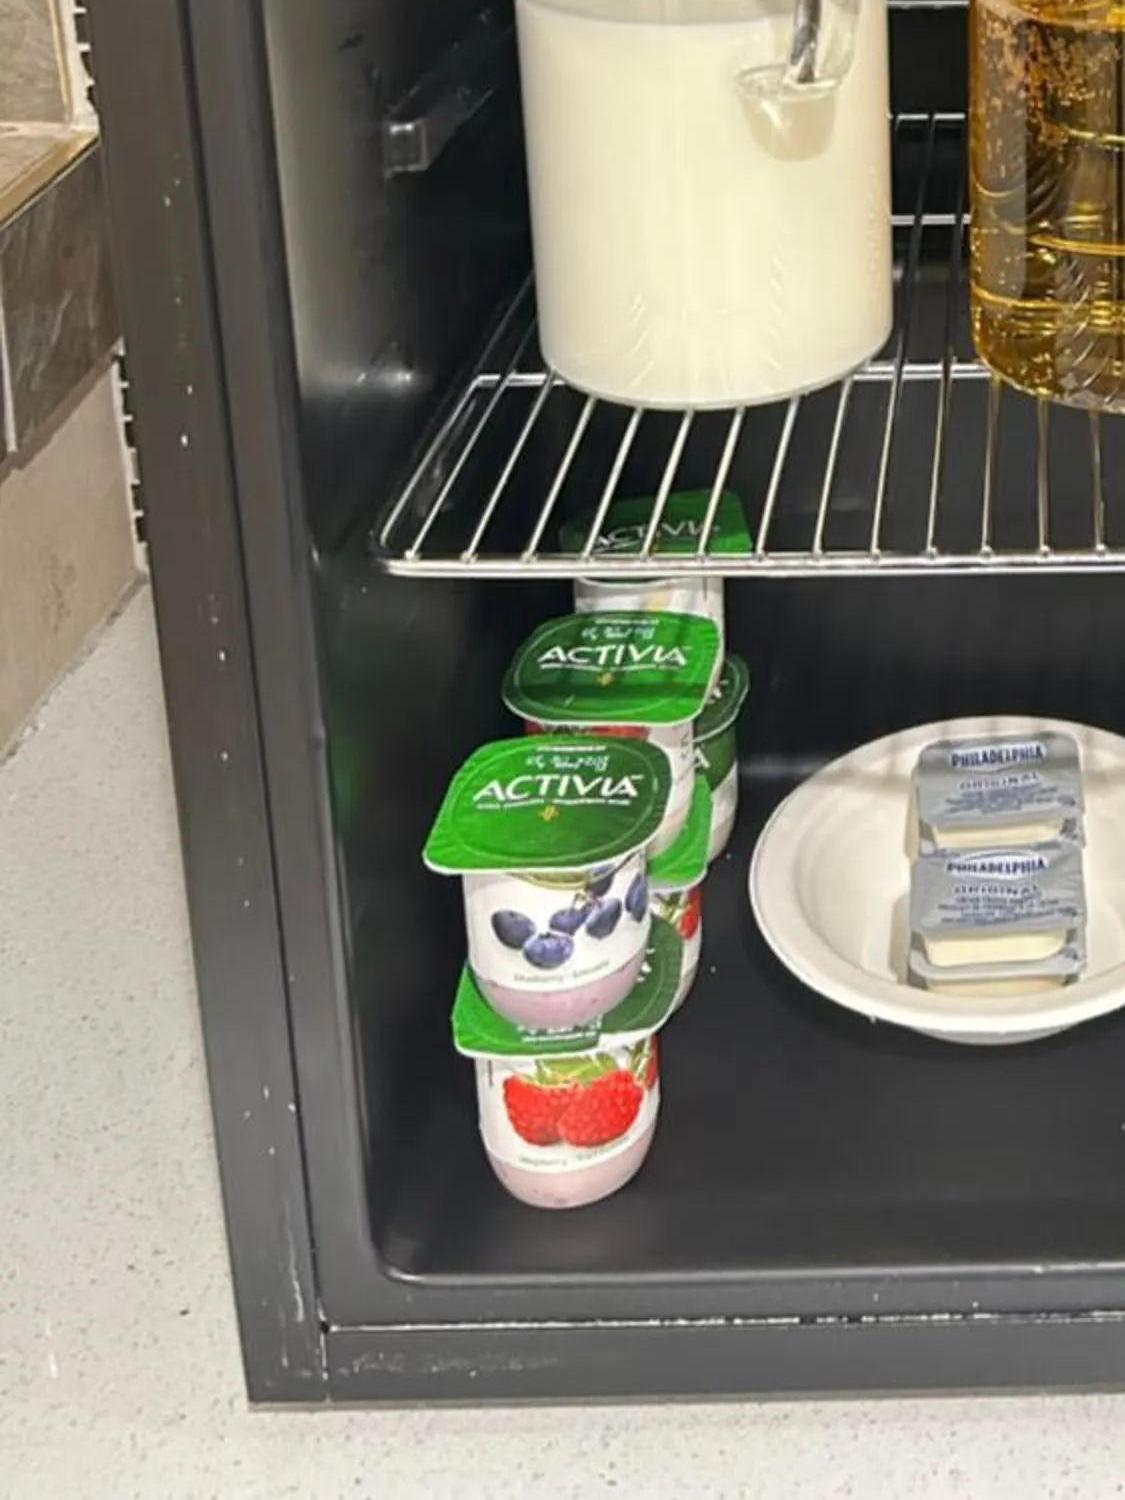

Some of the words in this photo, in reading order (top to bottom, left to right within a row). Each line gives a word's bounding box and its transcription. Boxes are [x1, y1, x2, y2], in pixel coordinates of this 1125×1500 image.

[537, 643, 688, 666] ACTIVIA
[951, 745, 1042, 767] PHILADELPHIA
[472, 774, 640, 802] ACTIVIA
[947, 857, 1046, 874] PHILADELPHIA
